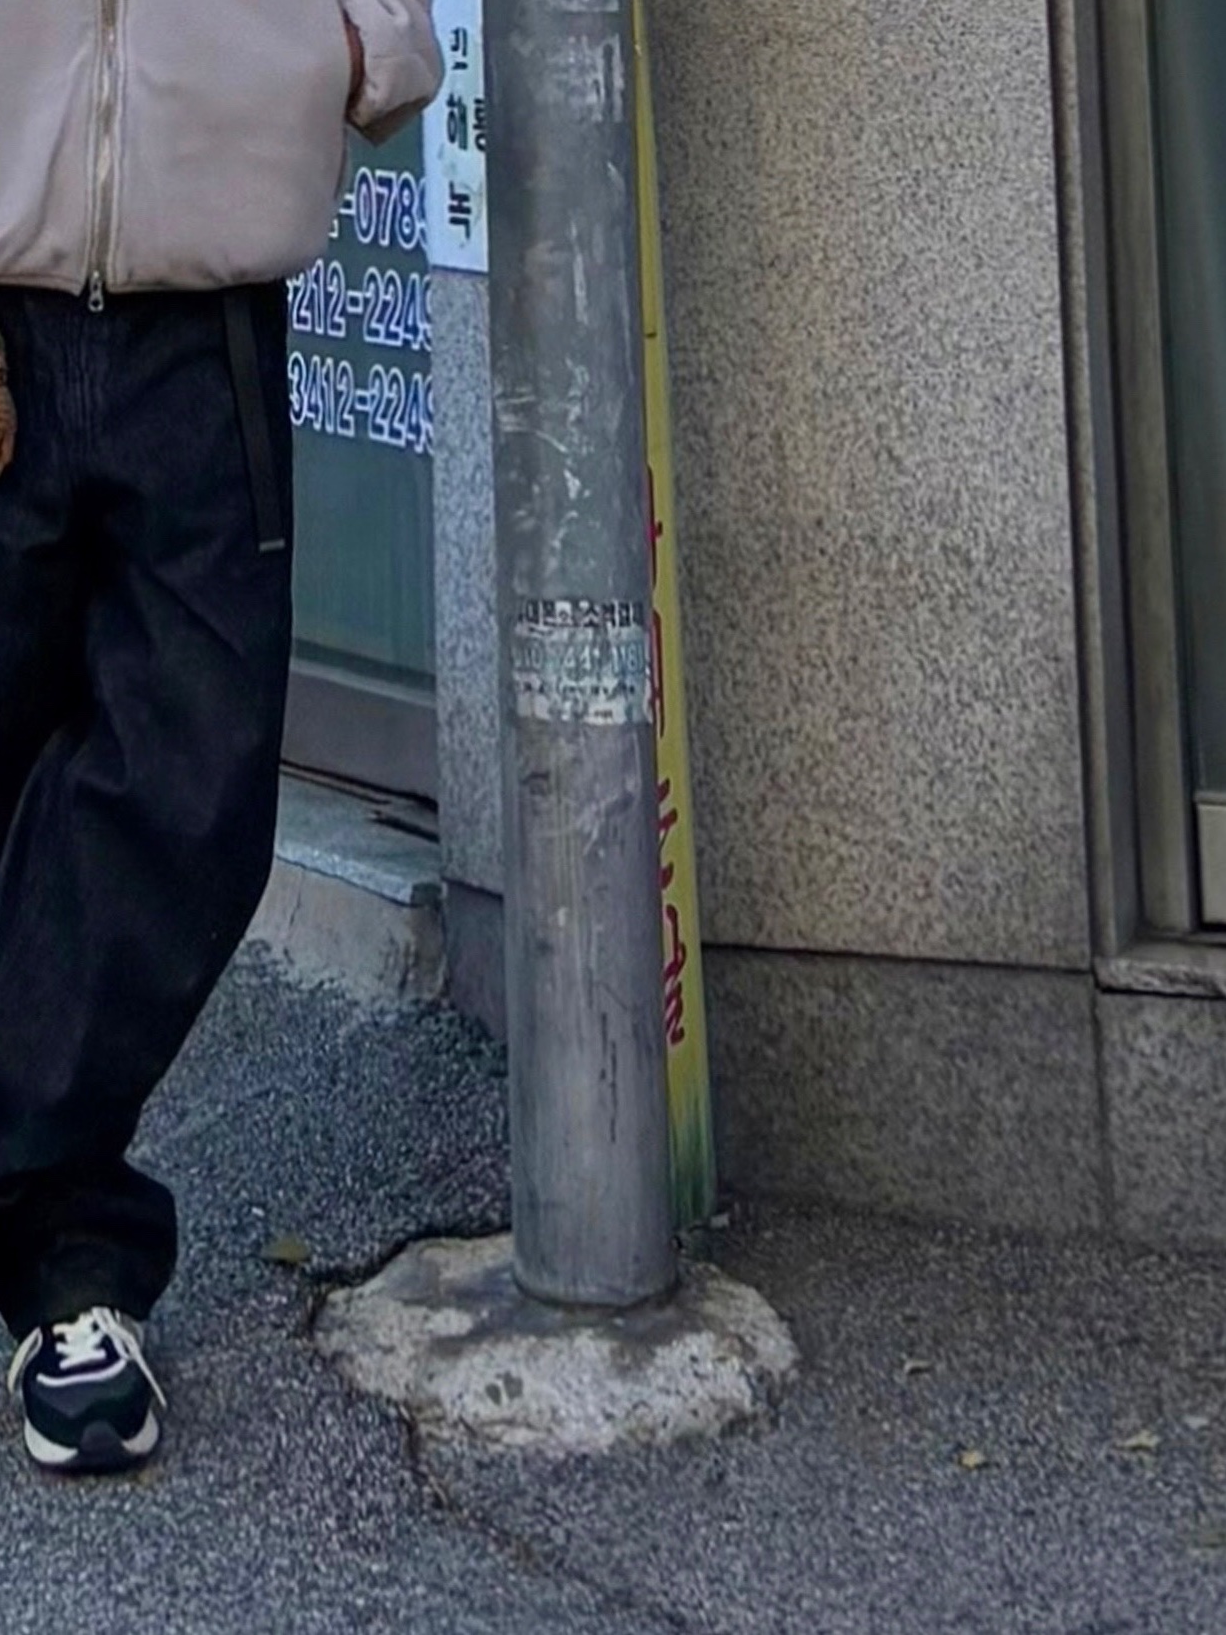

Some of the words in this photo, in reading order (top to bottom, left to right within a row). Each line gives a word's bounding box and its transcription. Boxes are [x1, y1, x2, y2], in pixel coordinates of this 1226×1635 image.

[327, 166, 432, 250] -078
[286, 258, 432, 352] 212-224
[288, 351, 434, 456] 3412-224
